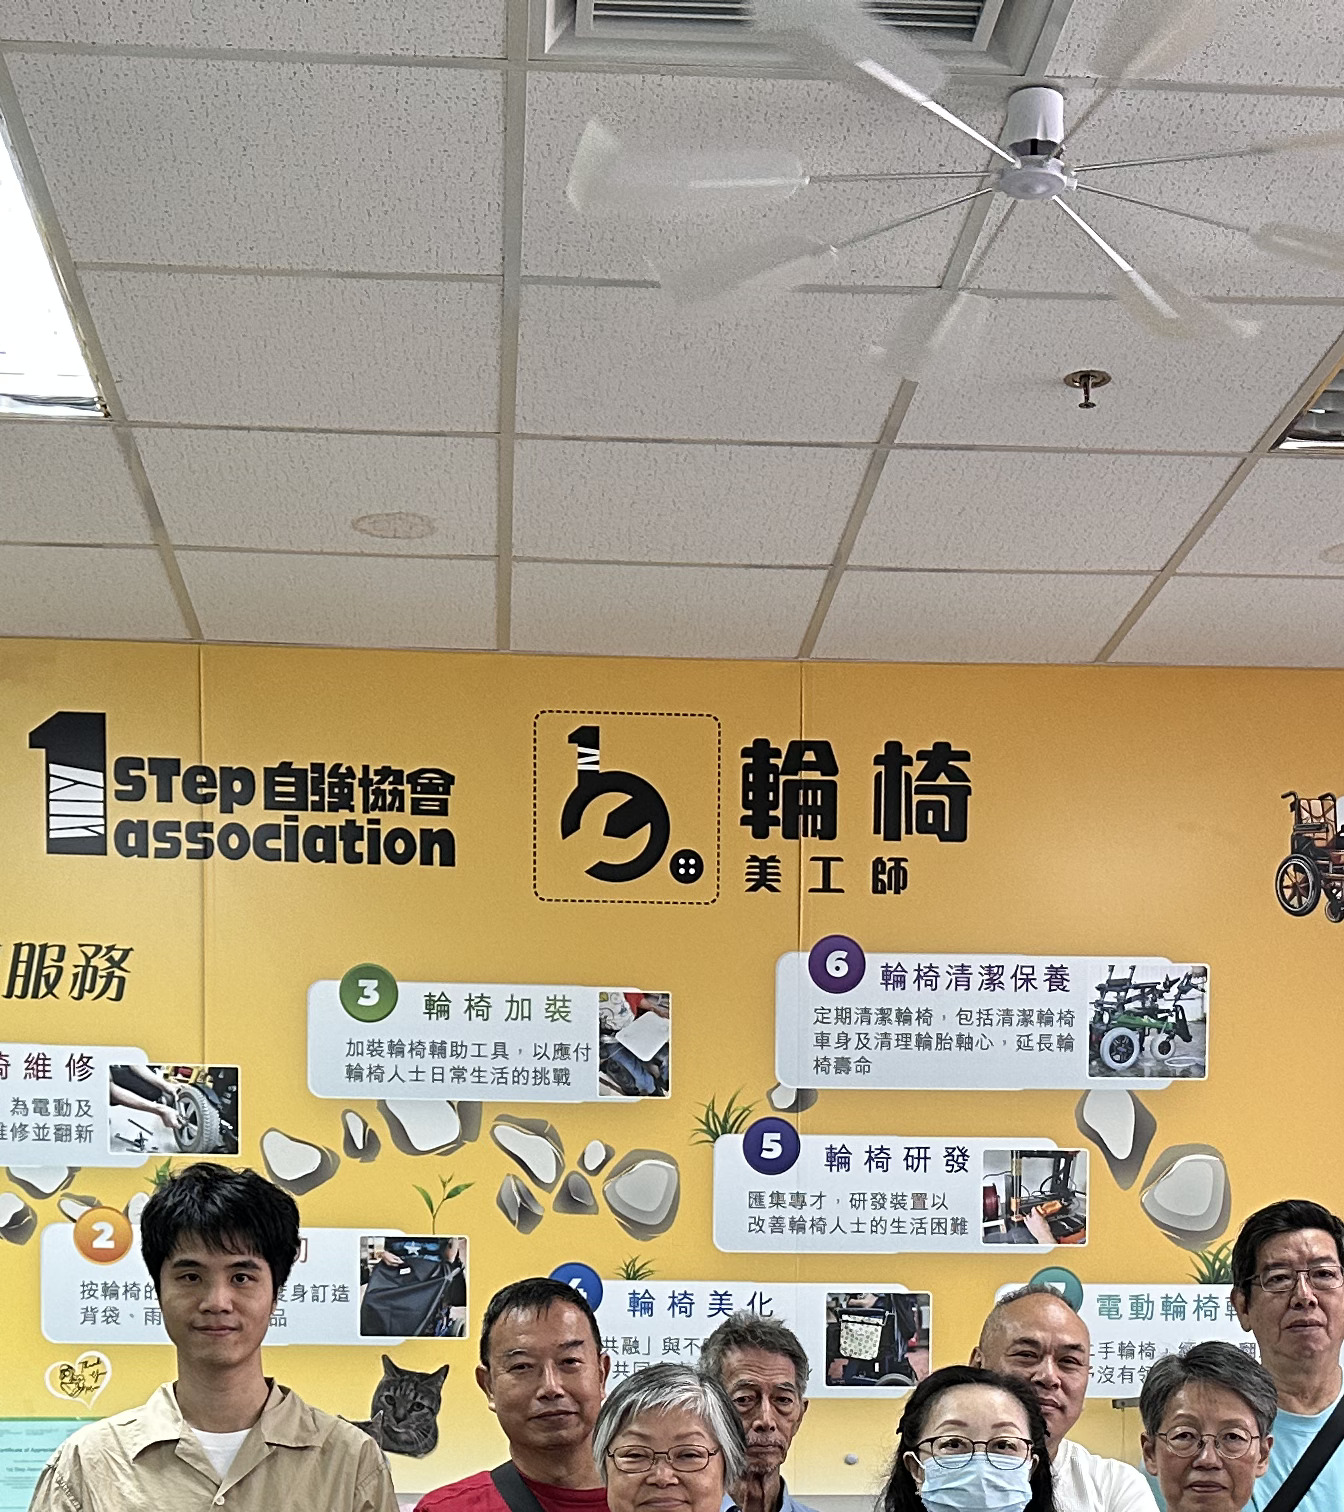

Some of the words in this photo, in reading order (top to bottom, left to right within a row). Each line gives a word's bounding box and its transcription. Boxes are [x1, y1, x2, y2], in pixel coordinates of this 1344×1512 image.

[262, 761, 455, 817] 自強協會
[739, 737, 972, 843] 輪椅
[113, 815, 455, 867] association
[744, 854, 910, 895] 美工師
[825, 950, 849, 977] 6
[356, 978, 381, 1006] 3
[880, 962, 1072, 995] 輪椅清潔保養
[423, 992, 573, 1025] 輪椅加裝
[344, 1063, 572, 1089] 輪椅人士日常生活的挑戰
[812, 1055, 872, 1078] 椅壽命
[760, 1133, 783, 1160] 5
[824, 1144, 970, 1174] 輪椅研發
[92, 1222, 115, 1249] 2
[748, 1215, 969, 1236] 改善輪椅人士的生活困難
[628, 1289, 775, 1318] 輪椅美化
[601, 1336, 708, 1357] 共融」與不
